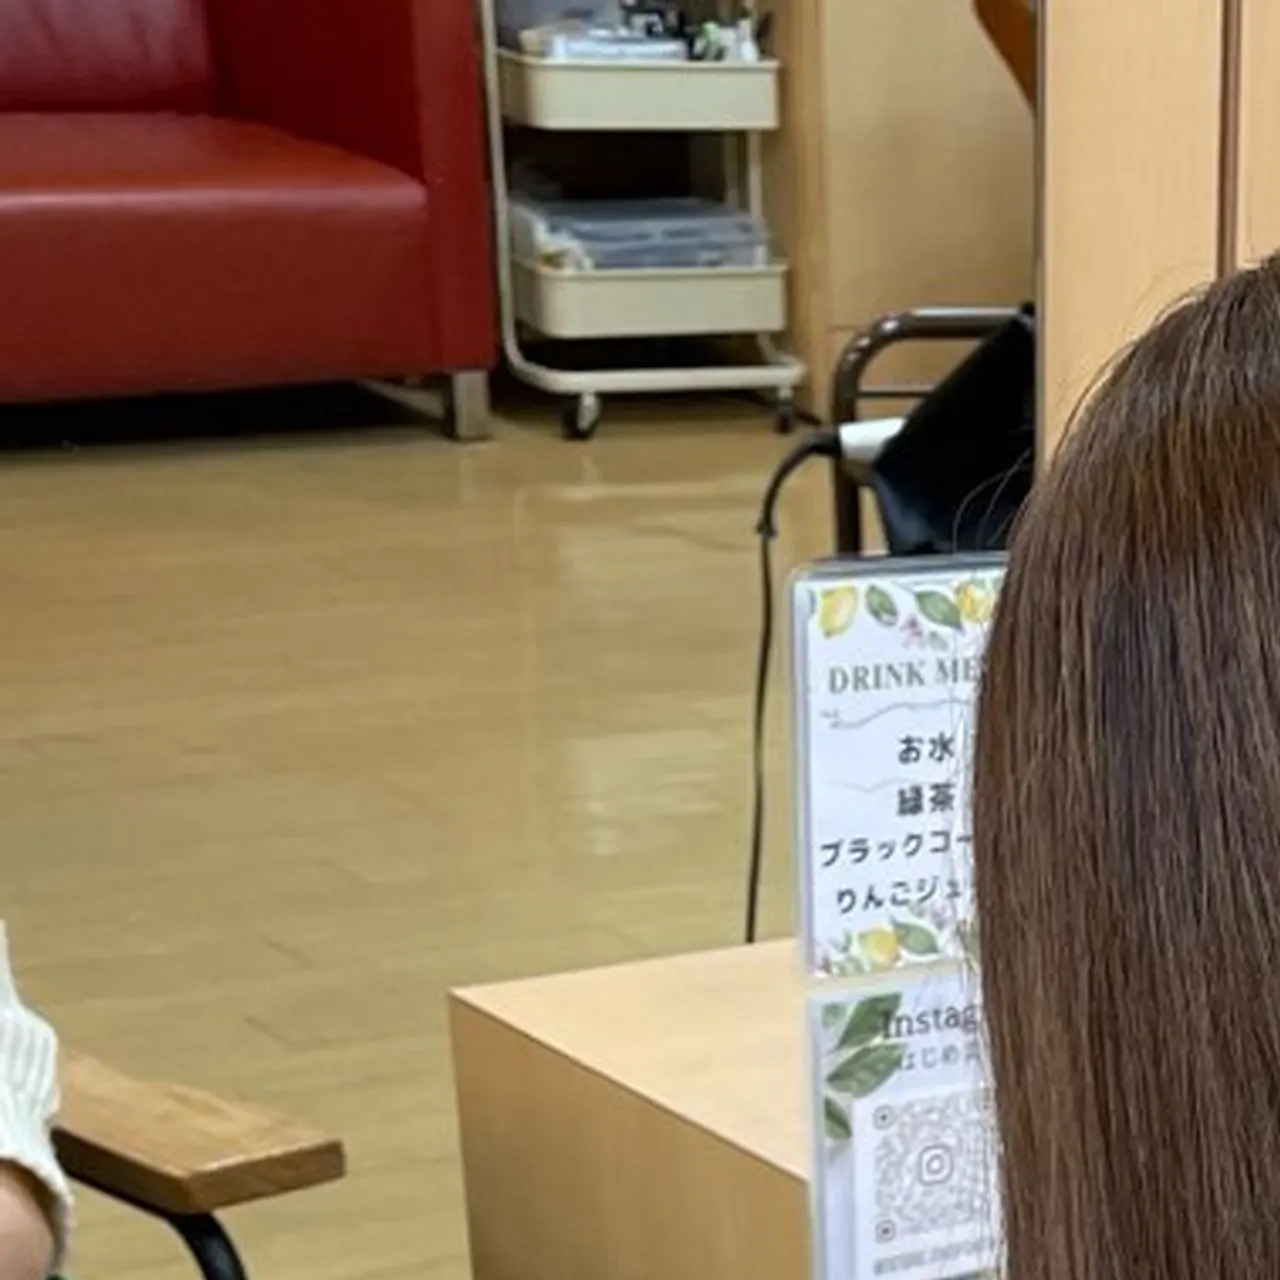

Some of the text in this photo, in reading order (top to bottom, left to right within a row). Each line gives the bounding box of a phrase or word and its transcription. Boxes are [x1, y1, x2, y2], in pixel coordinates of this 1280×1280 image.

[828, 657, 980, 694] DRINK ME
[898, 731, 955, 765] お水
